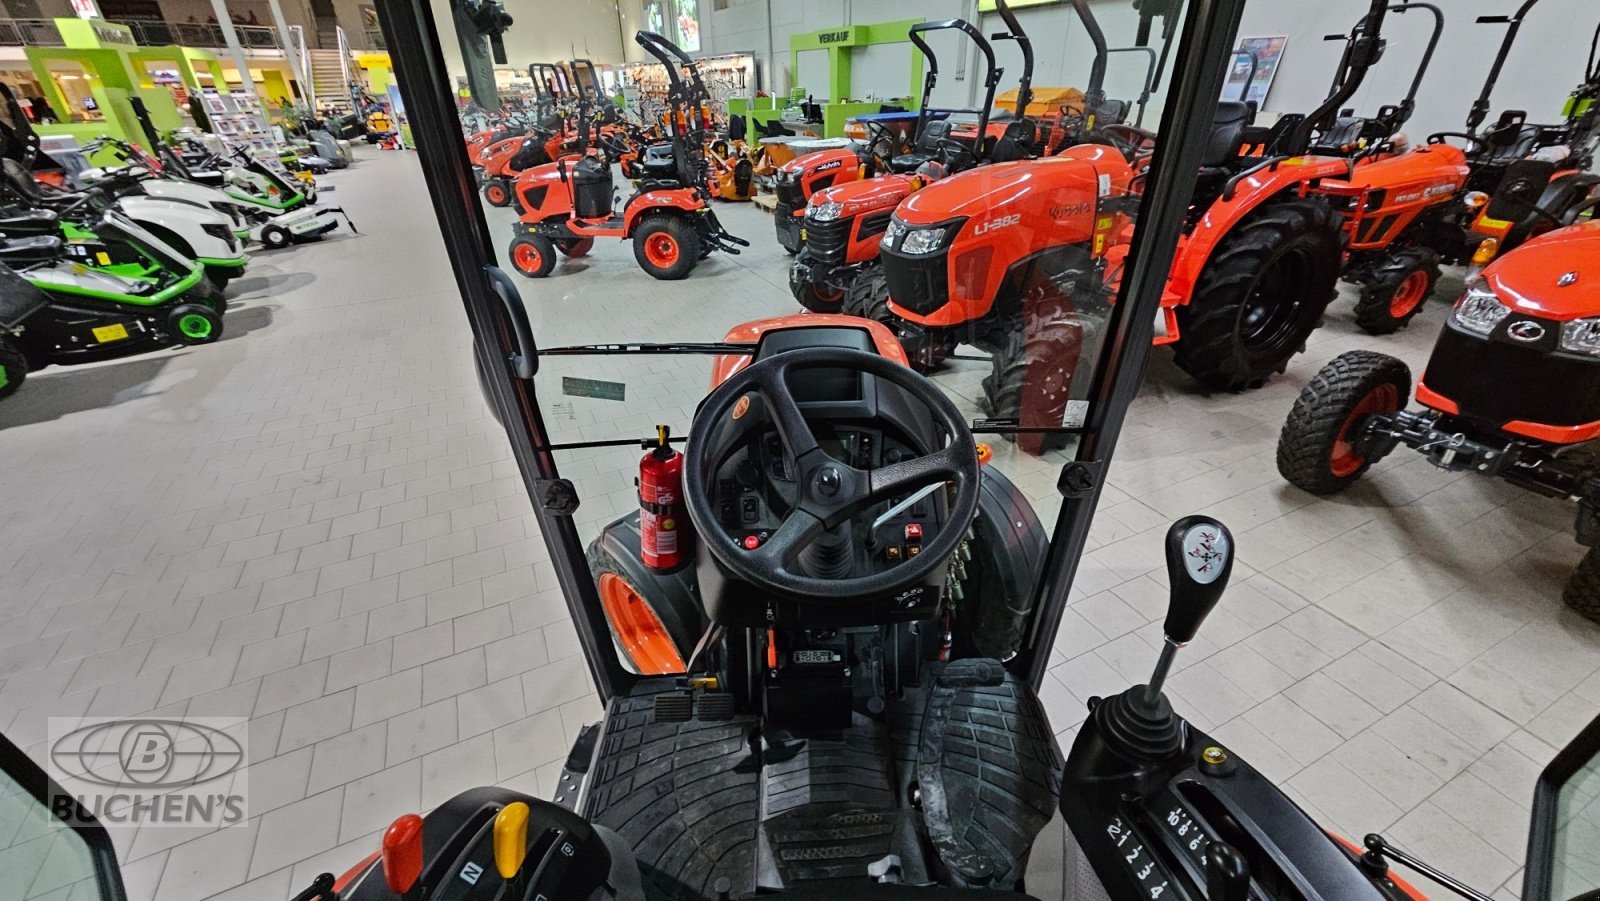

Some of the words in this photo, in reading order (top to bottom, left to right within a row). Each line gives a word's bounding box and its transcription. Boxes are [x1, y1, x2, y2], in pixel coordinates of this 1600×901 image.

[819, 30, 849, 44] VERKAUF
[974, 213, 1021, 236] L1-382
[1167, 811, 1180, 826] 10
[1178, 824, 1189, 836] 8
[1117, 835, 1128, 847] 1
[1189, 839, 1200, 850] 6
[1126, 848, 1139, 864] 2
[463, 865, 480, 880] N
[1137, 865, 1151, 880] 3
[1150, 886, 1164, 899] 4
